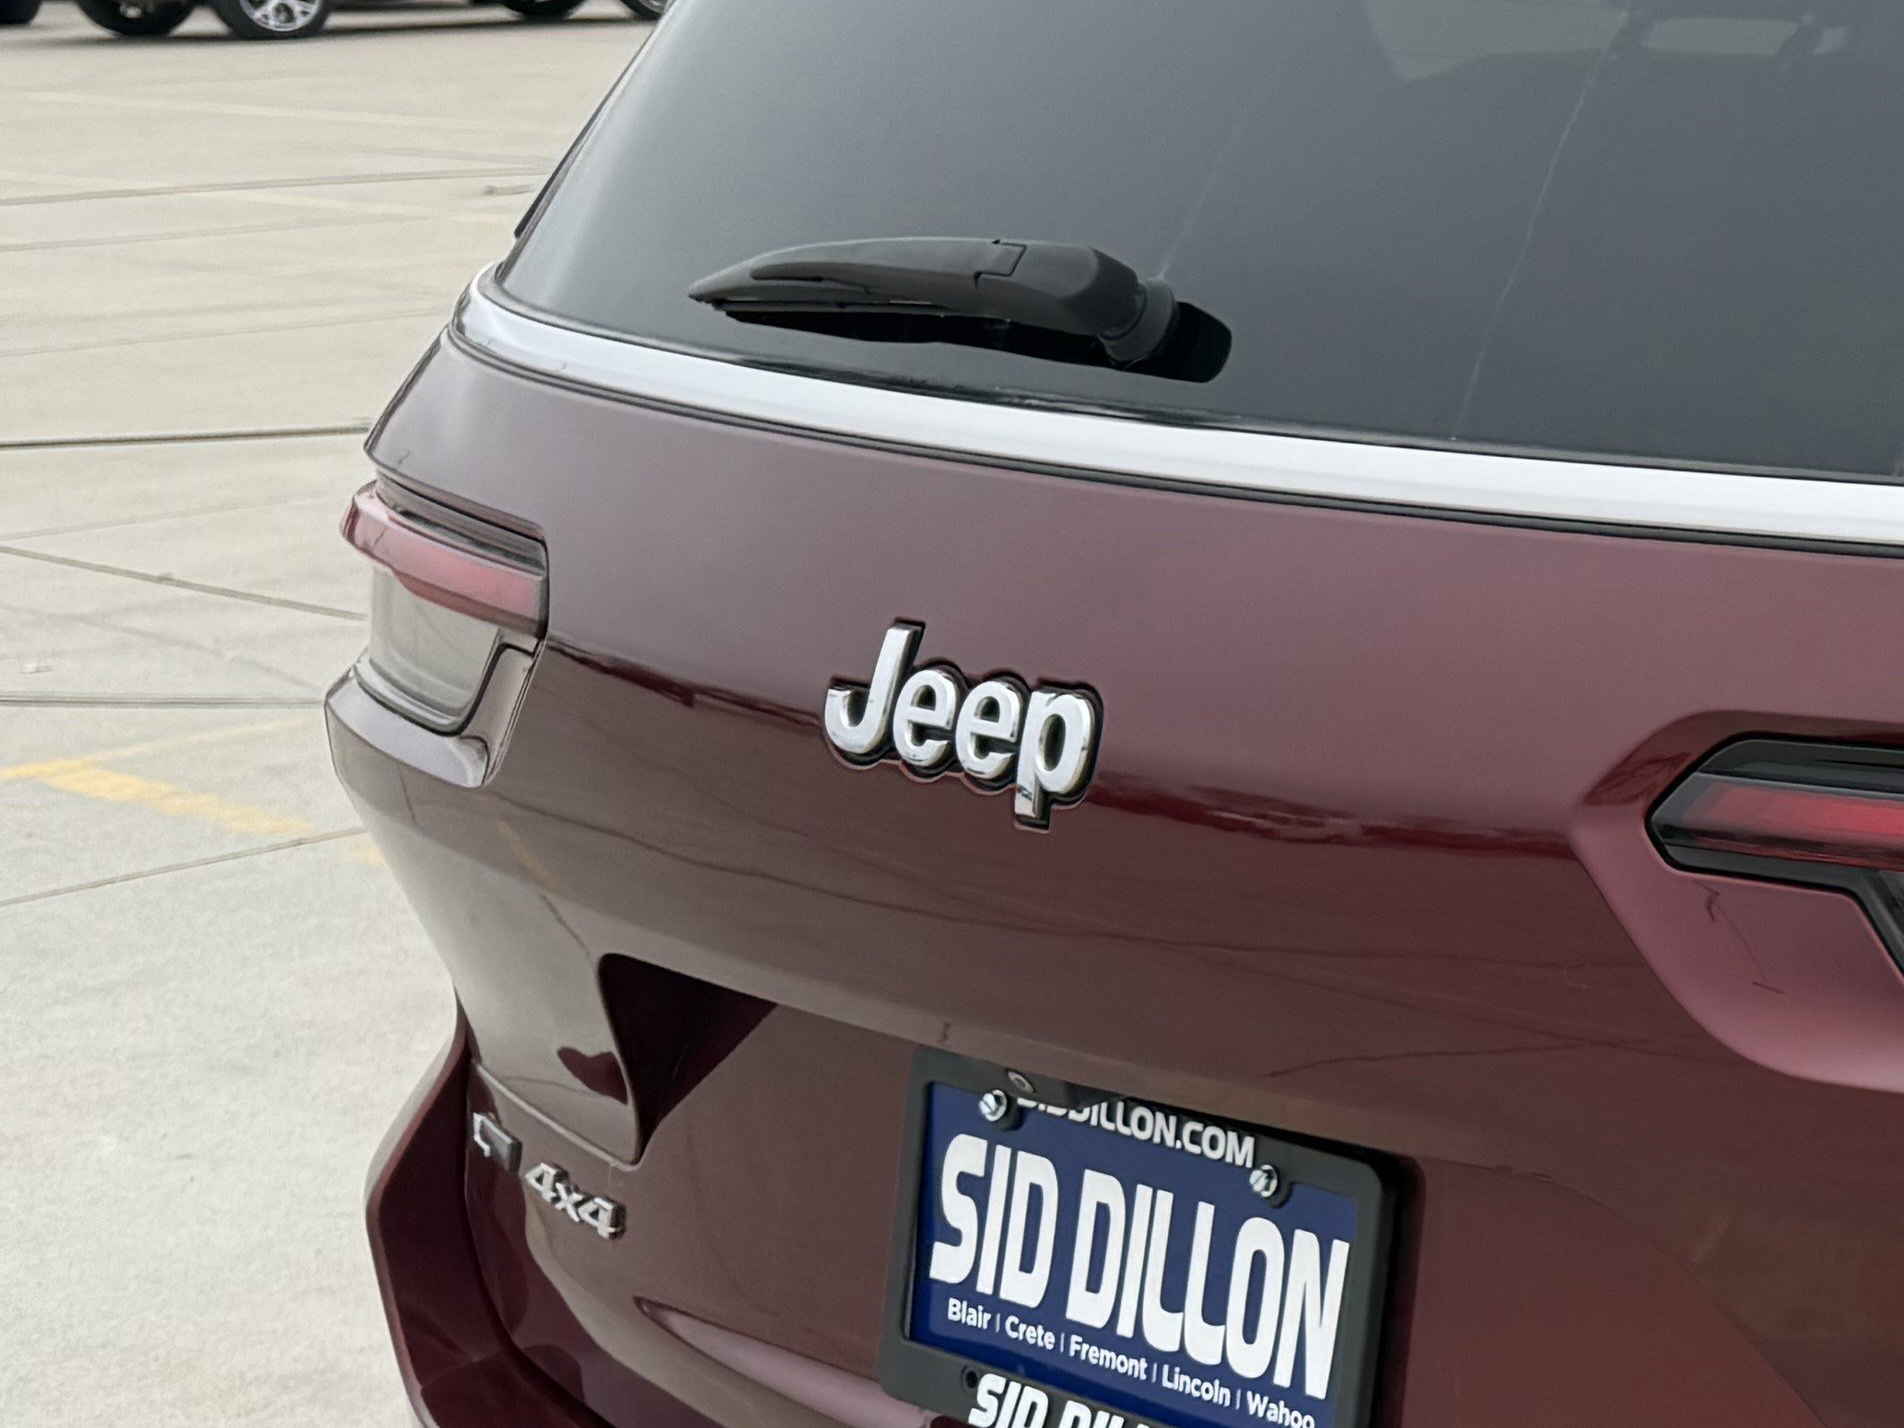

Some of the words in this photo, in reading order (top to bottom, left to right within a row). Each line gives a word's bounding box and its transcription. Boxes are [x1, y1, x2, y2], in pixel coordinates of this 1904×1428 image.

[823, 623, 1101, 823] Jeep
[1017, 1096, 1256, 1169] ILLON.COM
[525, 1162, 624, 1240] 4x4
[929, 1133, 1060, 1310] SID
[1065, 1168, 1351, 1401] DILLON
[947, 1296, 992, 1333] Blair
[1005, 1315, 1056, 1351] Crete
[1069, 1334, 1149, 1382] Fremont
[1161, 1363, 1232, 1408] Lincoln
